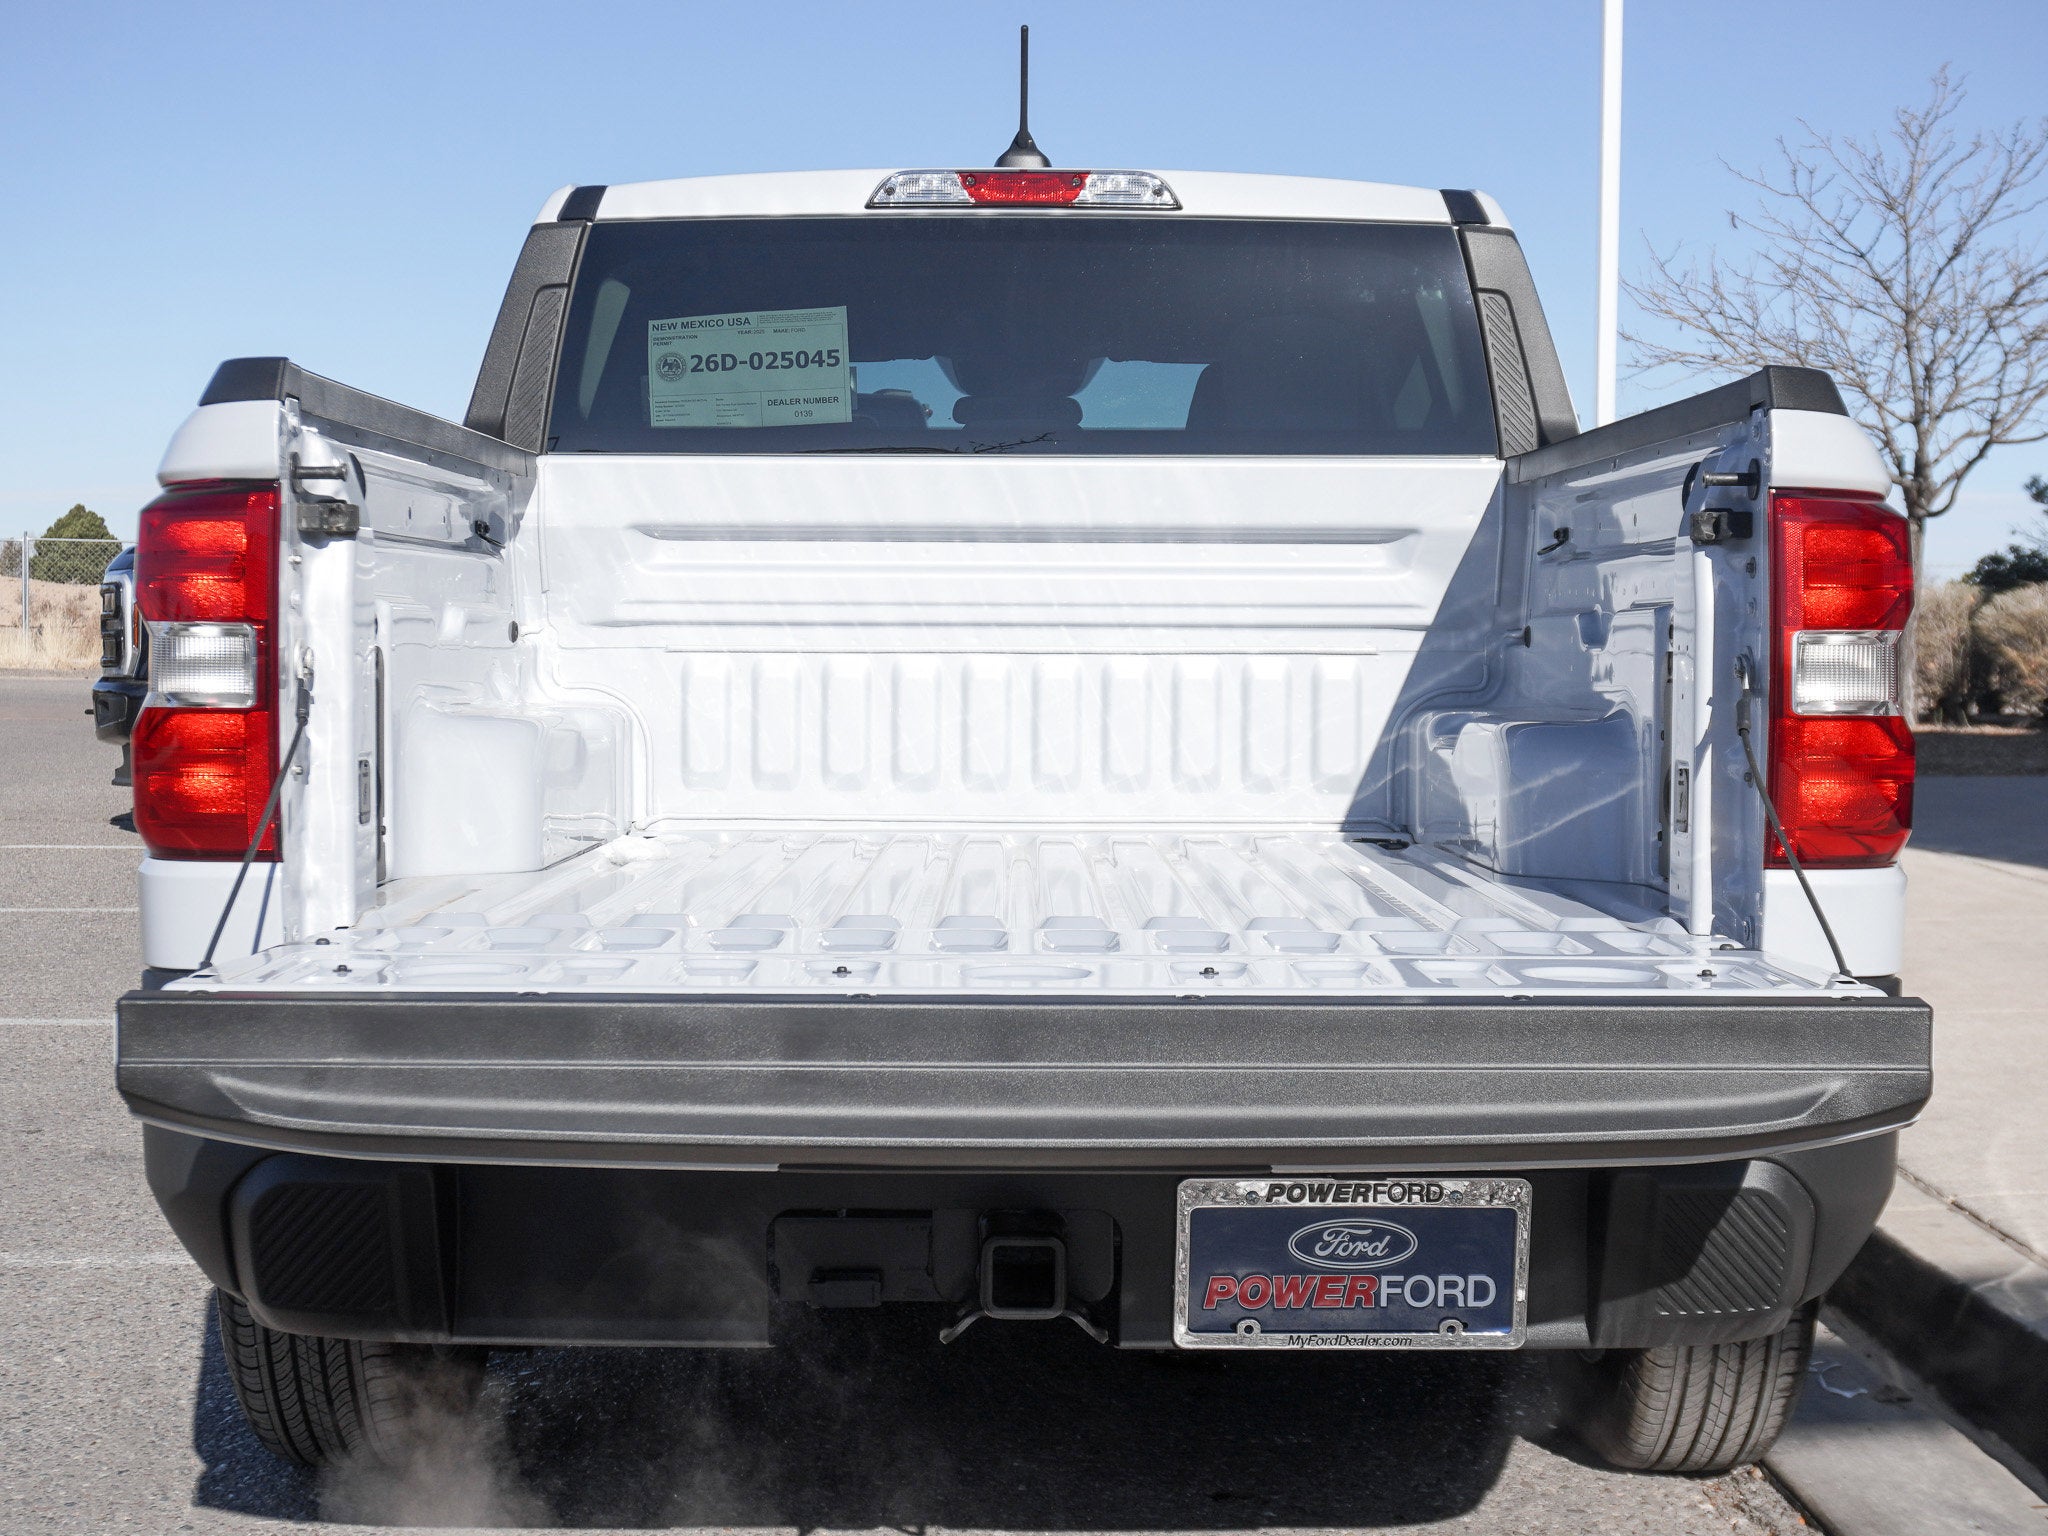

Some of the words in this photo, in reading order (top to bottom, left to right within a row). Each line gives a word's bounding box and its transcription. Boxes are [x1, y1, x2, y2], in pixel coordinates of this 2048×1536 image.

[652, 322, 678, 332] NEW
[681, 318, 724, 330] MEXICO
[727, 317, 751, 327] USA
[690, 349, 841, 373] 26D-025045
[767, 398, 801, 407] DEALER
[803, 396, 839, 404] NUMBER
[794, 410, 813, 418] 0139
[1265, 1182, 1445, 1204] POWERFORD
[1314, 1227, 1390, 1258] Ford
[1203, 1273, 1497, 1310] POWERFORD
[1287, 1333, 1413, 1349] MyFordDealer.com
